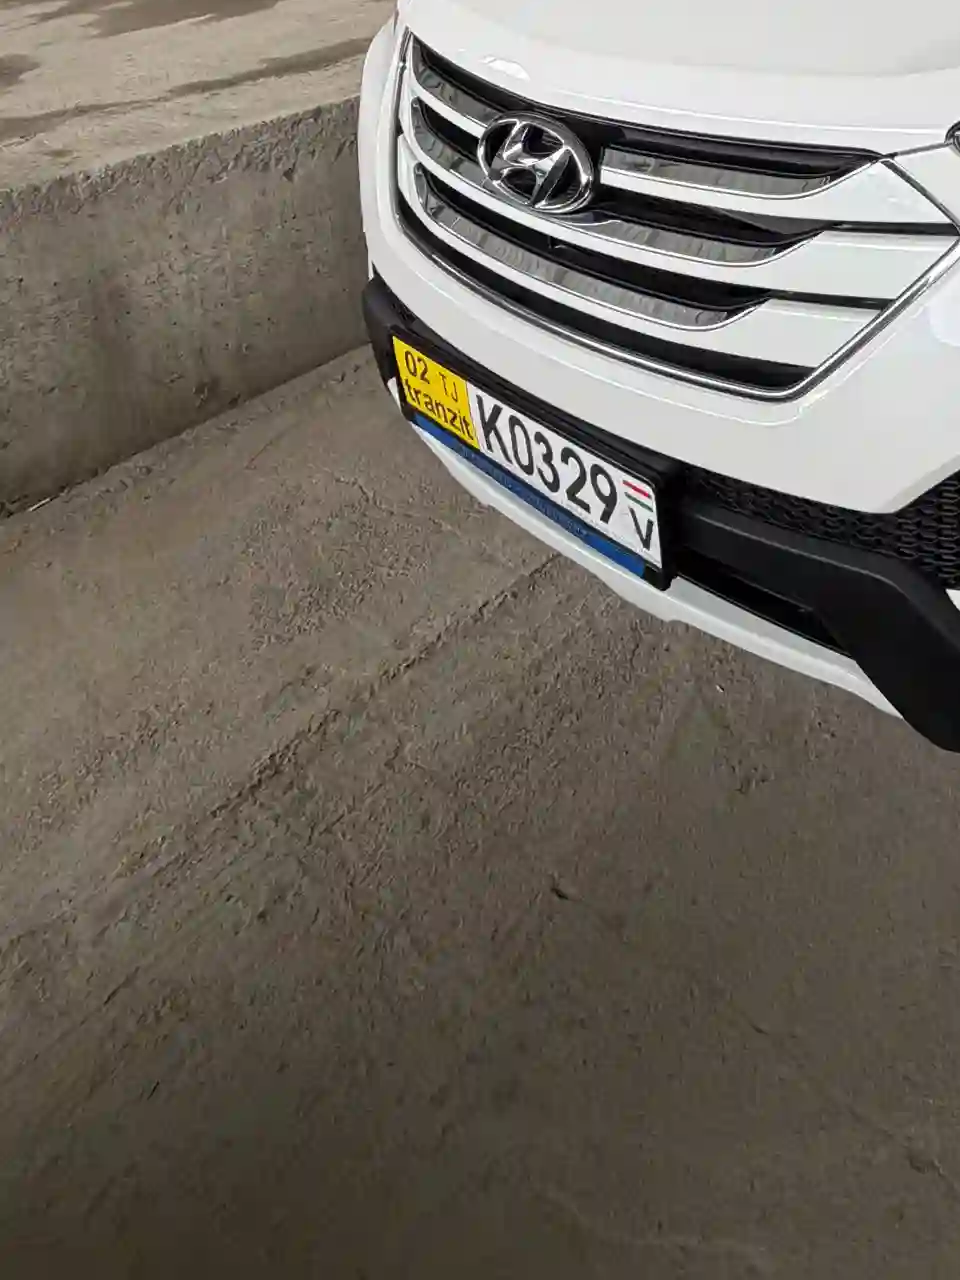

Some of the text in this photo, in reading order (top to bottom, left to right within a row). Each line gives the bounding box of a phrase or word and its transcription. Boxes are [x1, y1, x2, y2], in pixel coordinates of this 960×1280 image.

[405, 350, 459, 403] 02 TJ
[405, 378, 474, 441] tranzit
[476, 394, 655, 551] K0329 V
